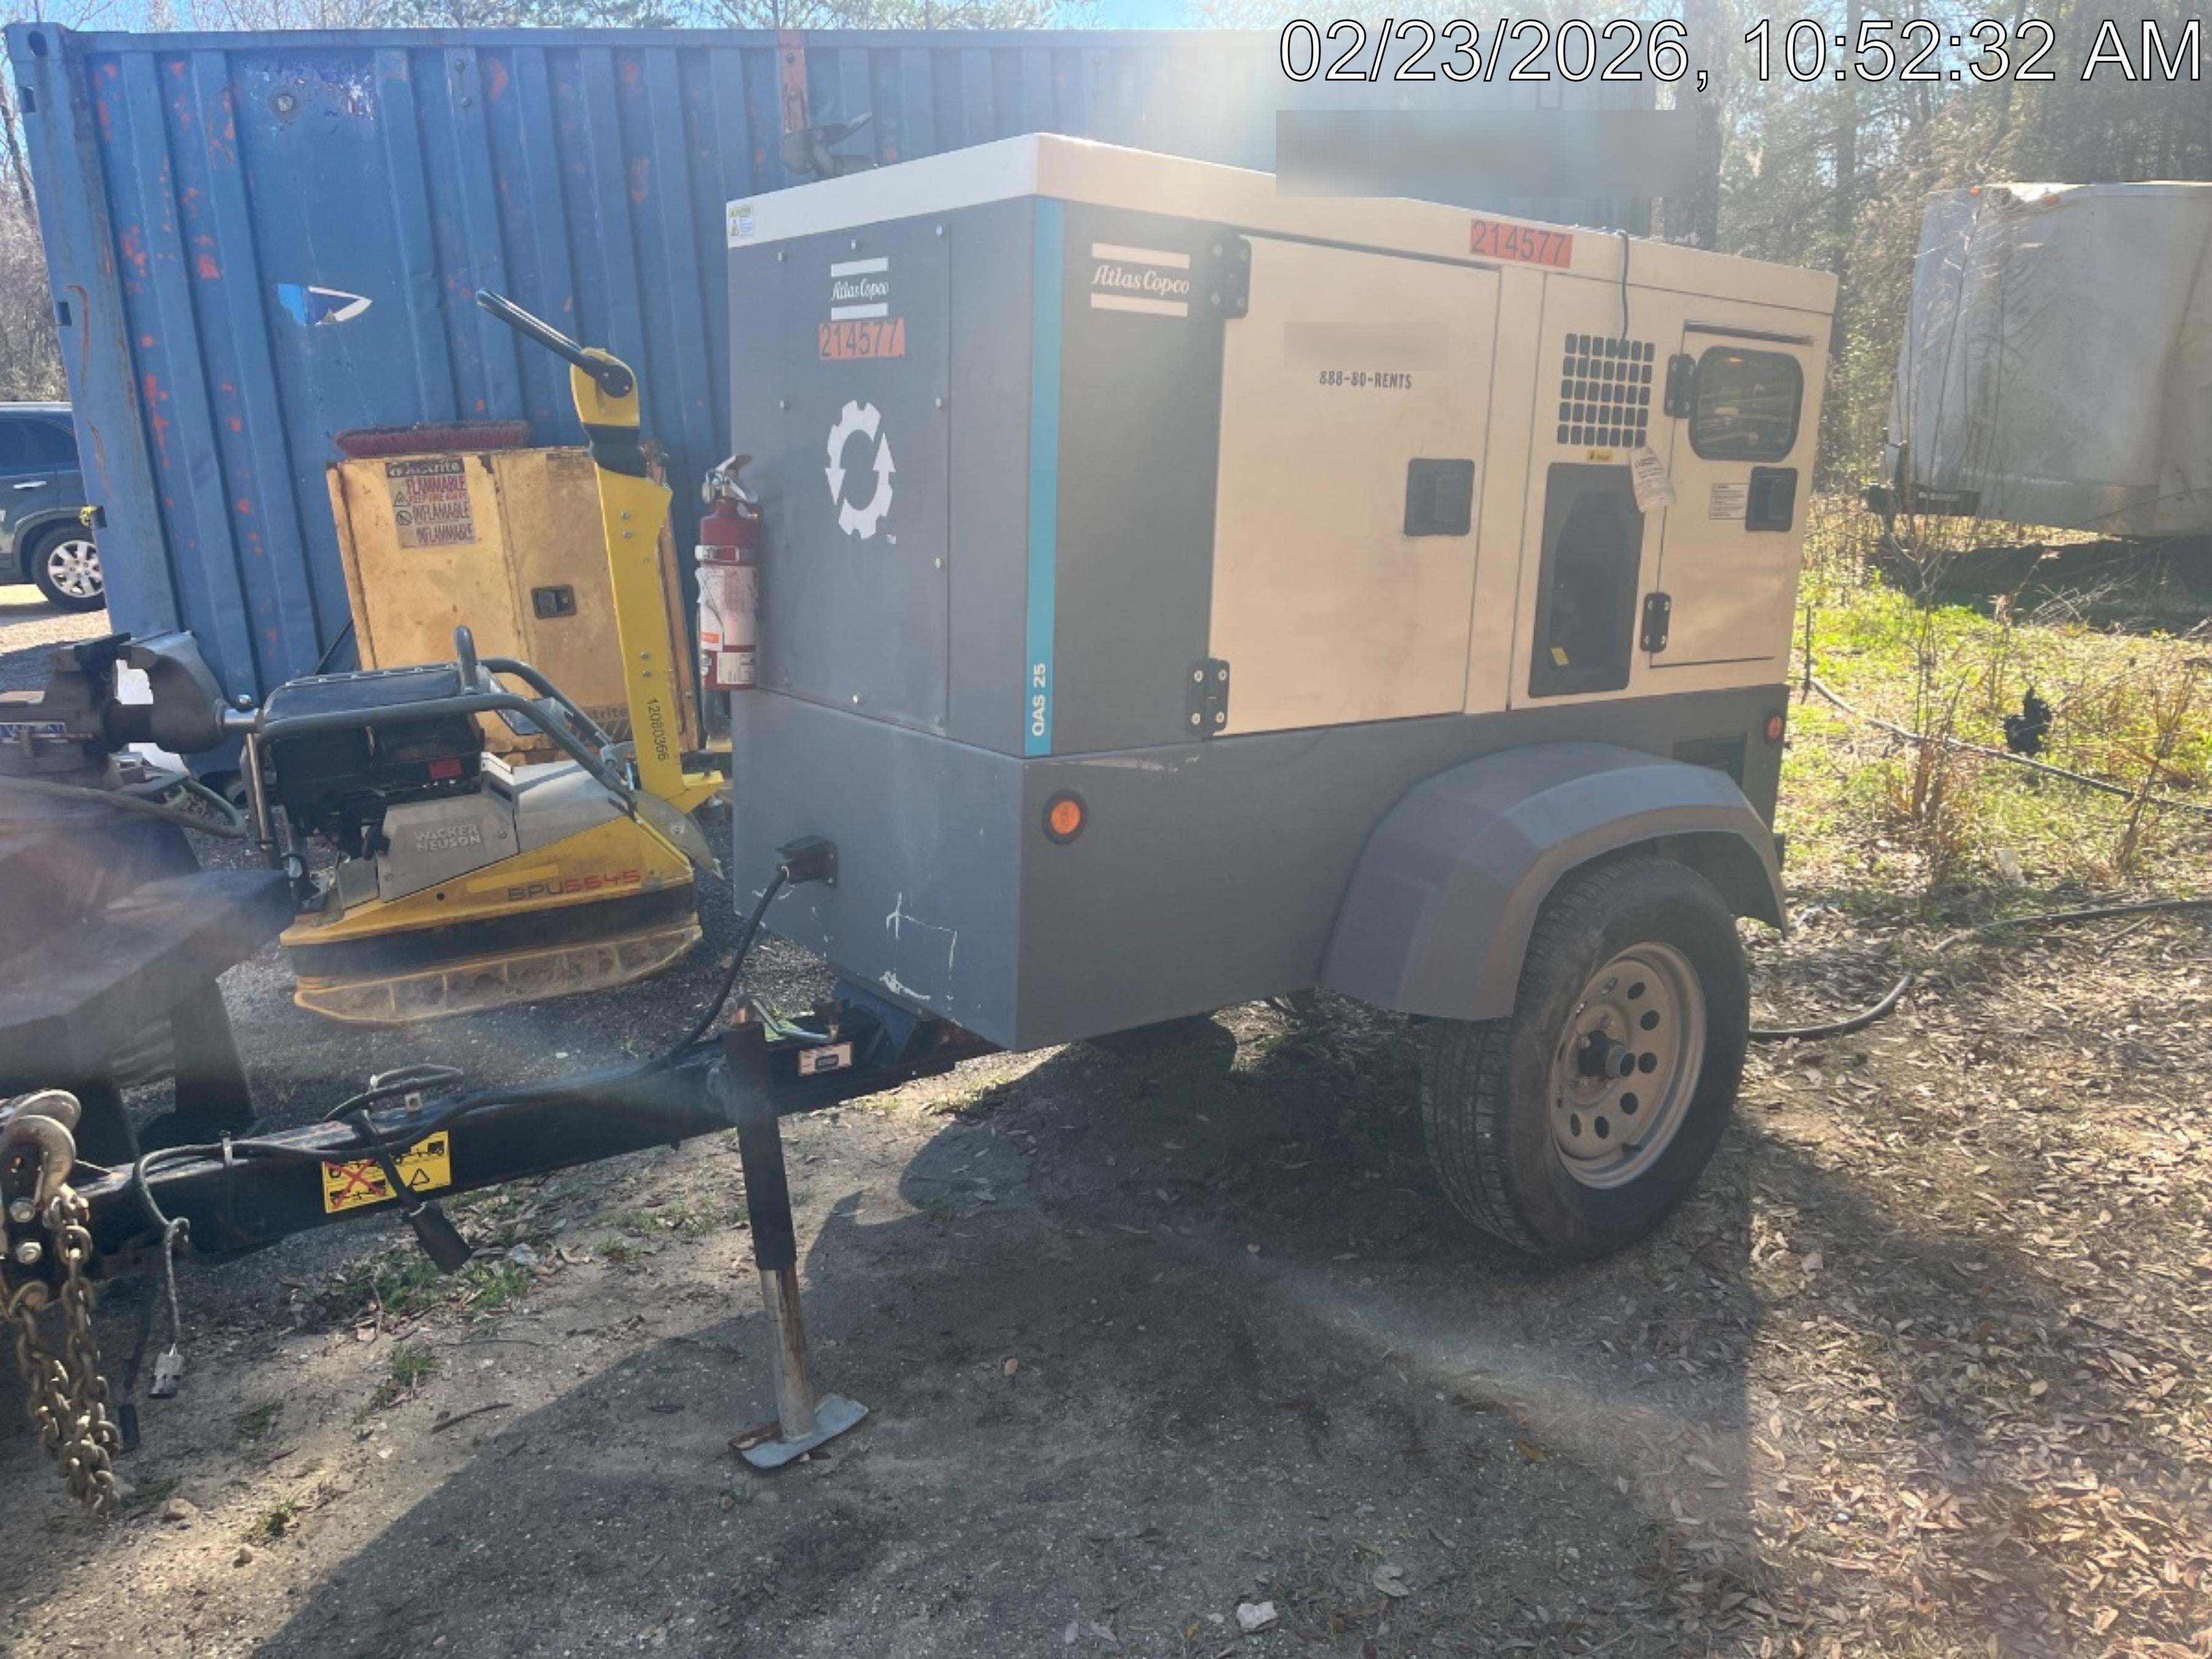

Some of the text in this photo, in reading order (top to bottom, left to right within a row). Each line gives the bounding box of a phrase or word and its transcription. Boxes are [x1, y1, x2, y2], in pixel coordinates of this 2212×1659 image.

[1472, 220, 1566, 265] 214577
[831, 278, 889, 300] Atlas Copco
[1091, 265, 1190, 296] Atlas Copco
[820, 319, 900, 357] 214577
[1319, 371, 1413, 390] 888-80-RENTS
[1032, 663, 1046, 736] QAS 25
[414, 824, 479, 841] WACKER
[416, 834, 482, 853] NEUSON
[508, 869, 641, 901] BPU5545
